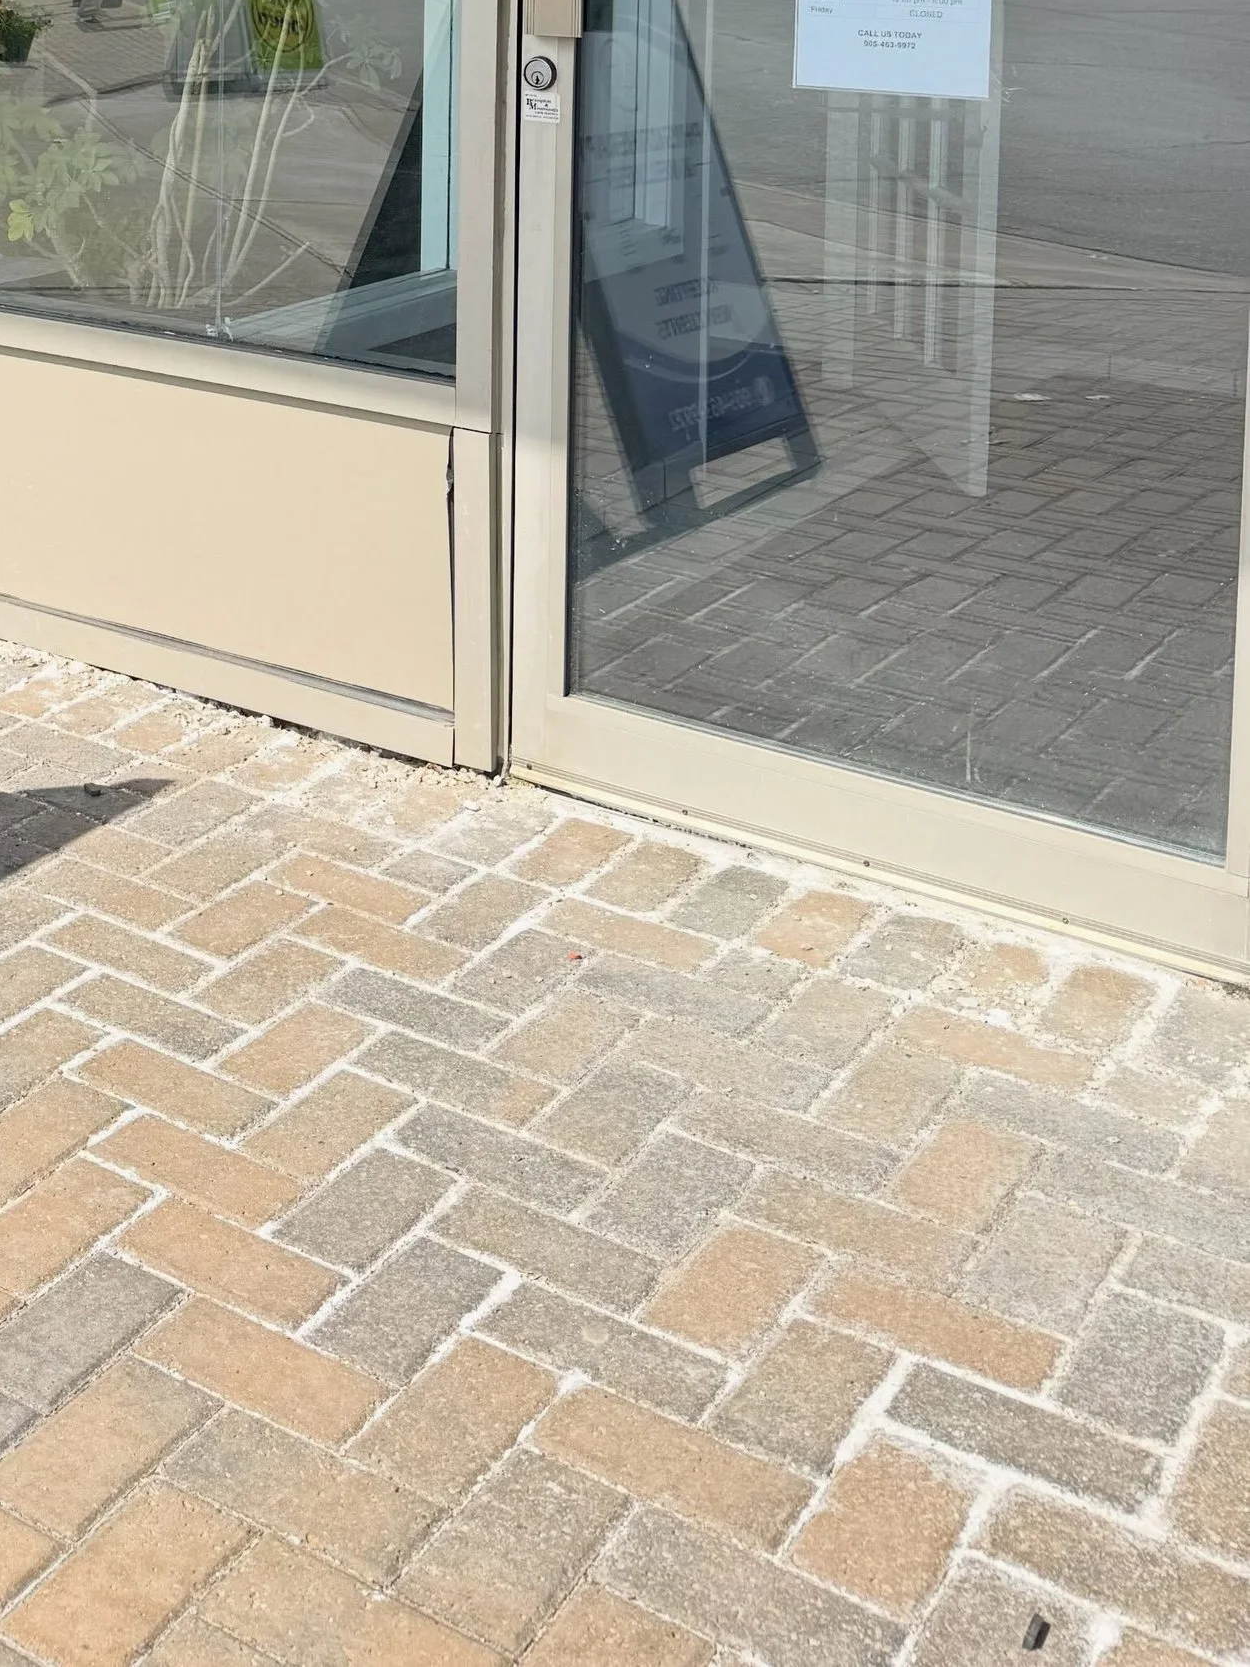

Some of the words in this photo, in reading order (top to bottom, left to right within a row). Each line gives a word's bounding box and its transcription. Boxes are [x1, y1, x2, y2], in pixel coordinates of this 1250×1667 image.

[810, 5, 833, 14] Friday
[909, 10, 943, 19] CLOSED
[857, 29, 879, 37] CALL
[880, 30, 892, 38] US
[894, 31, 923, 39] TODAY
